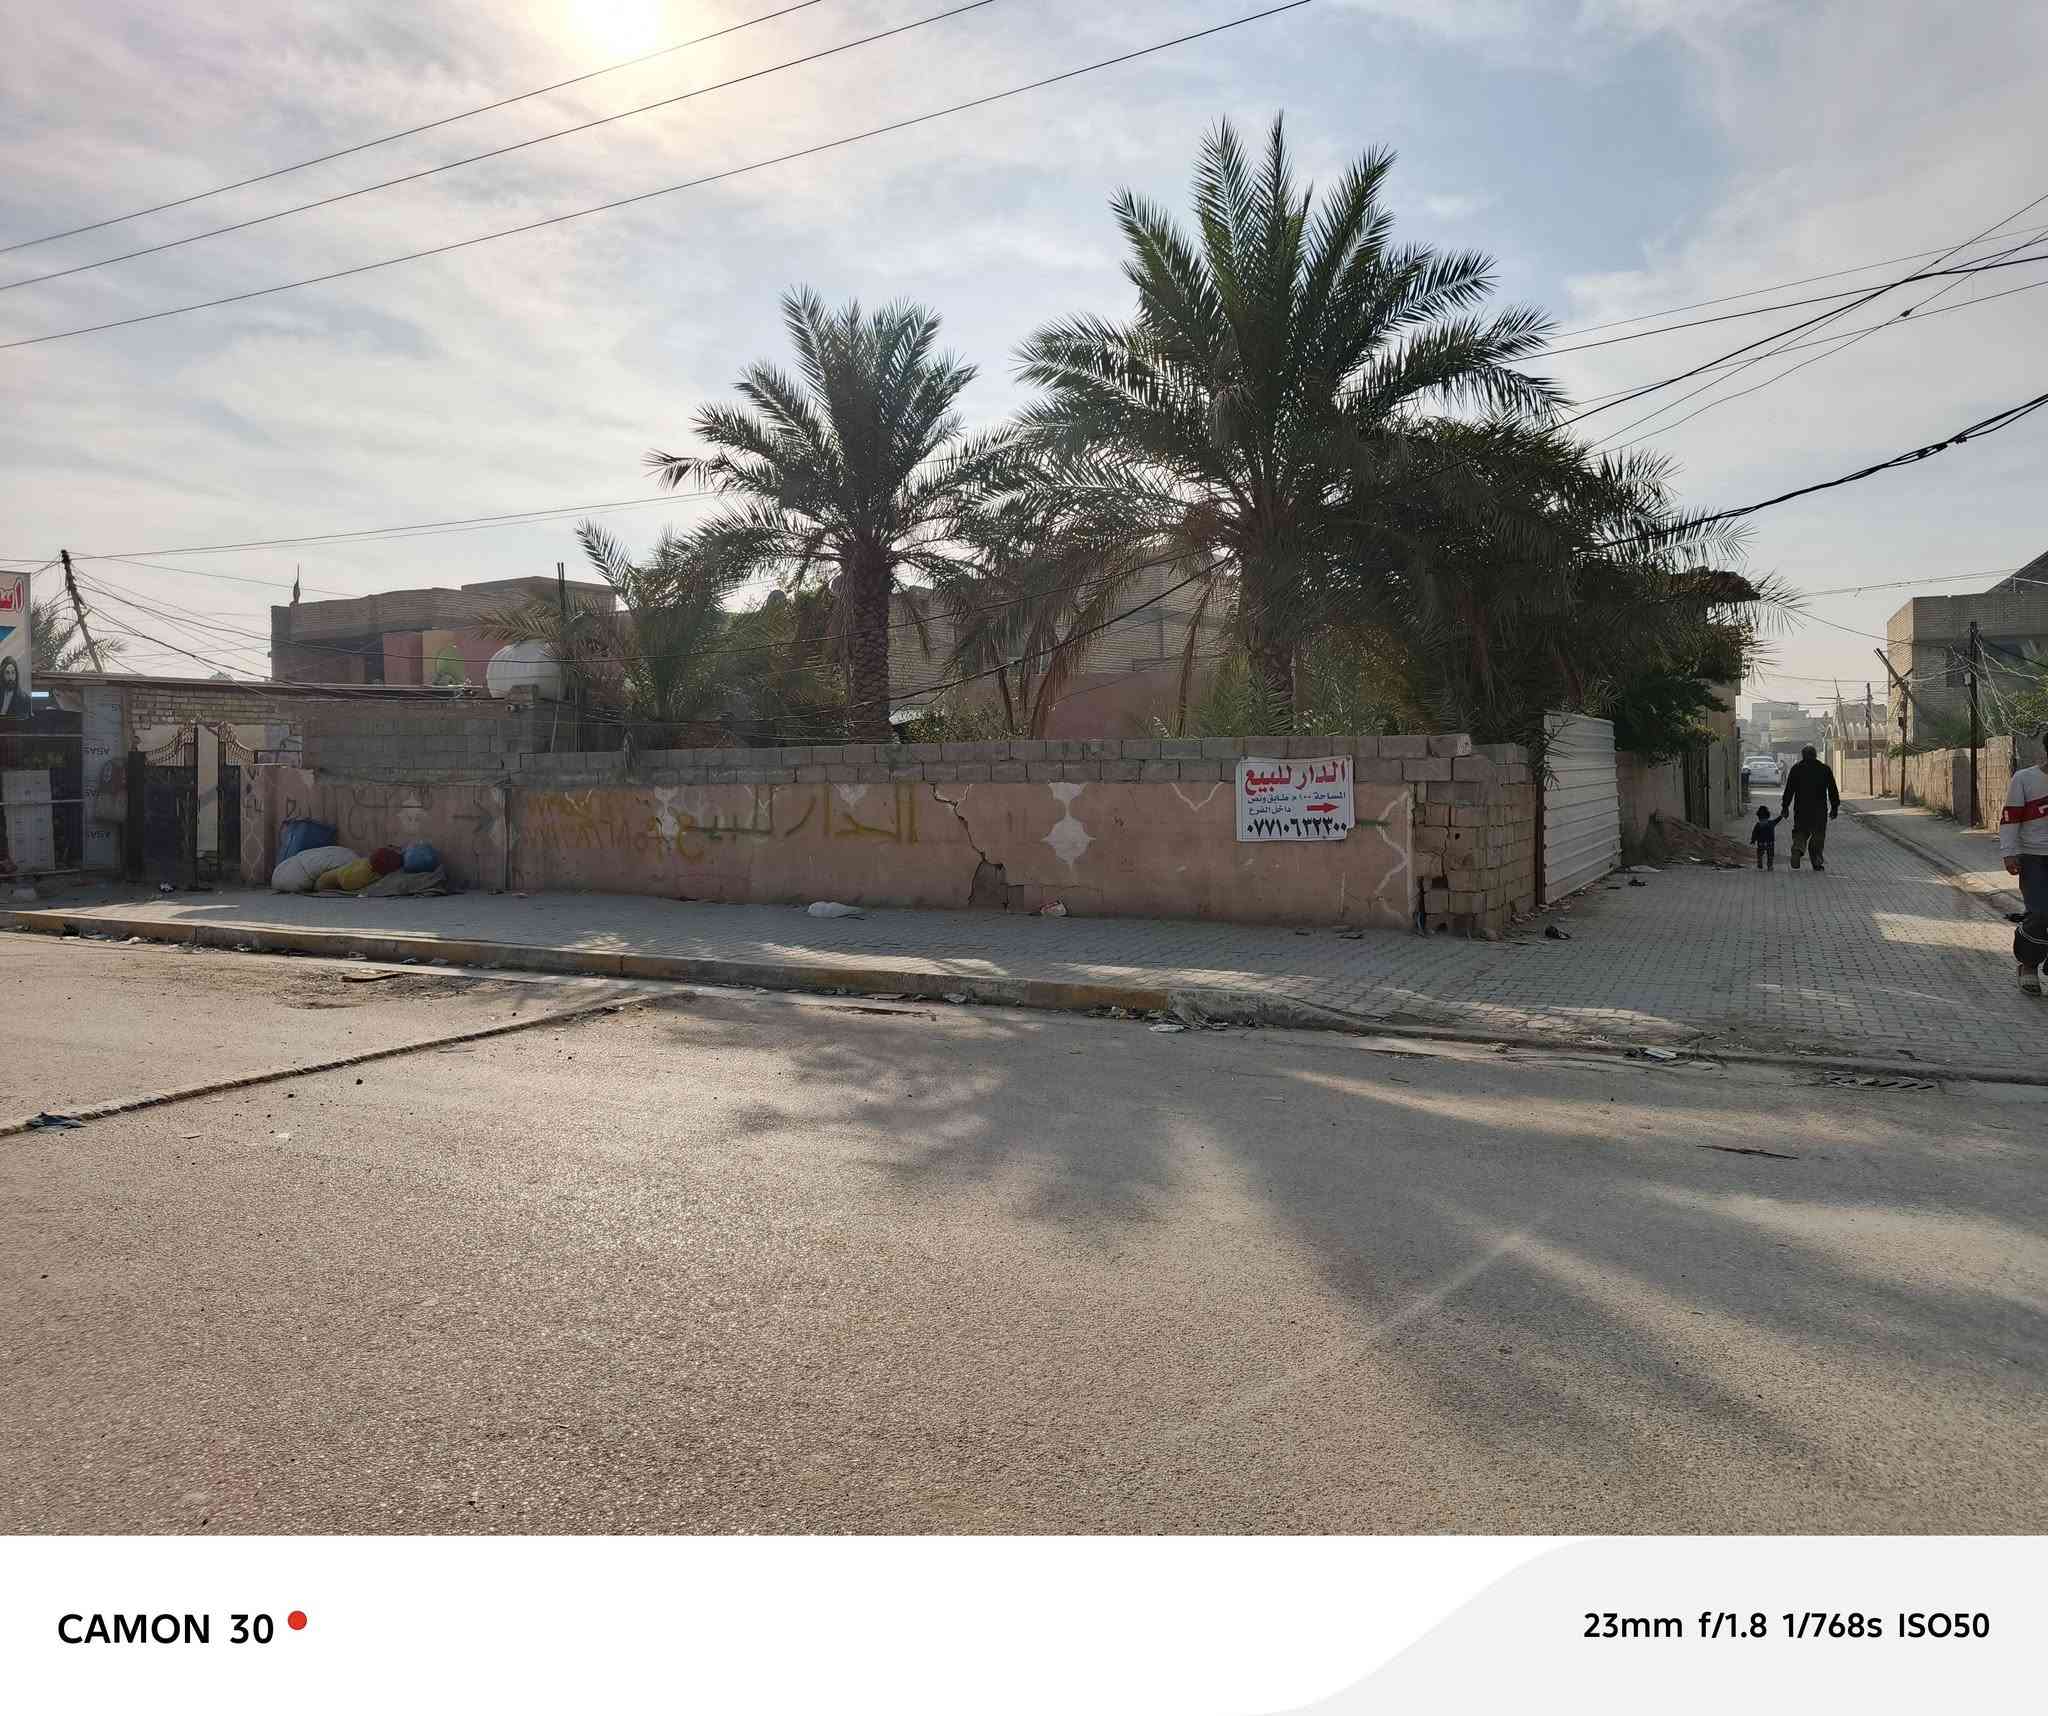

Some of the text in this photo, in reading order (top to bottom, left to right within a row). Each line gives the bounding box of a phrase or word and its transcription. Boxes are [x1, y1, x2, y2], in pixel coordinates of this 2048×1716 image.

[1245, 761, 1345, 795] الدار للبيع
[1312, 791, 1346, 800] المساحة
